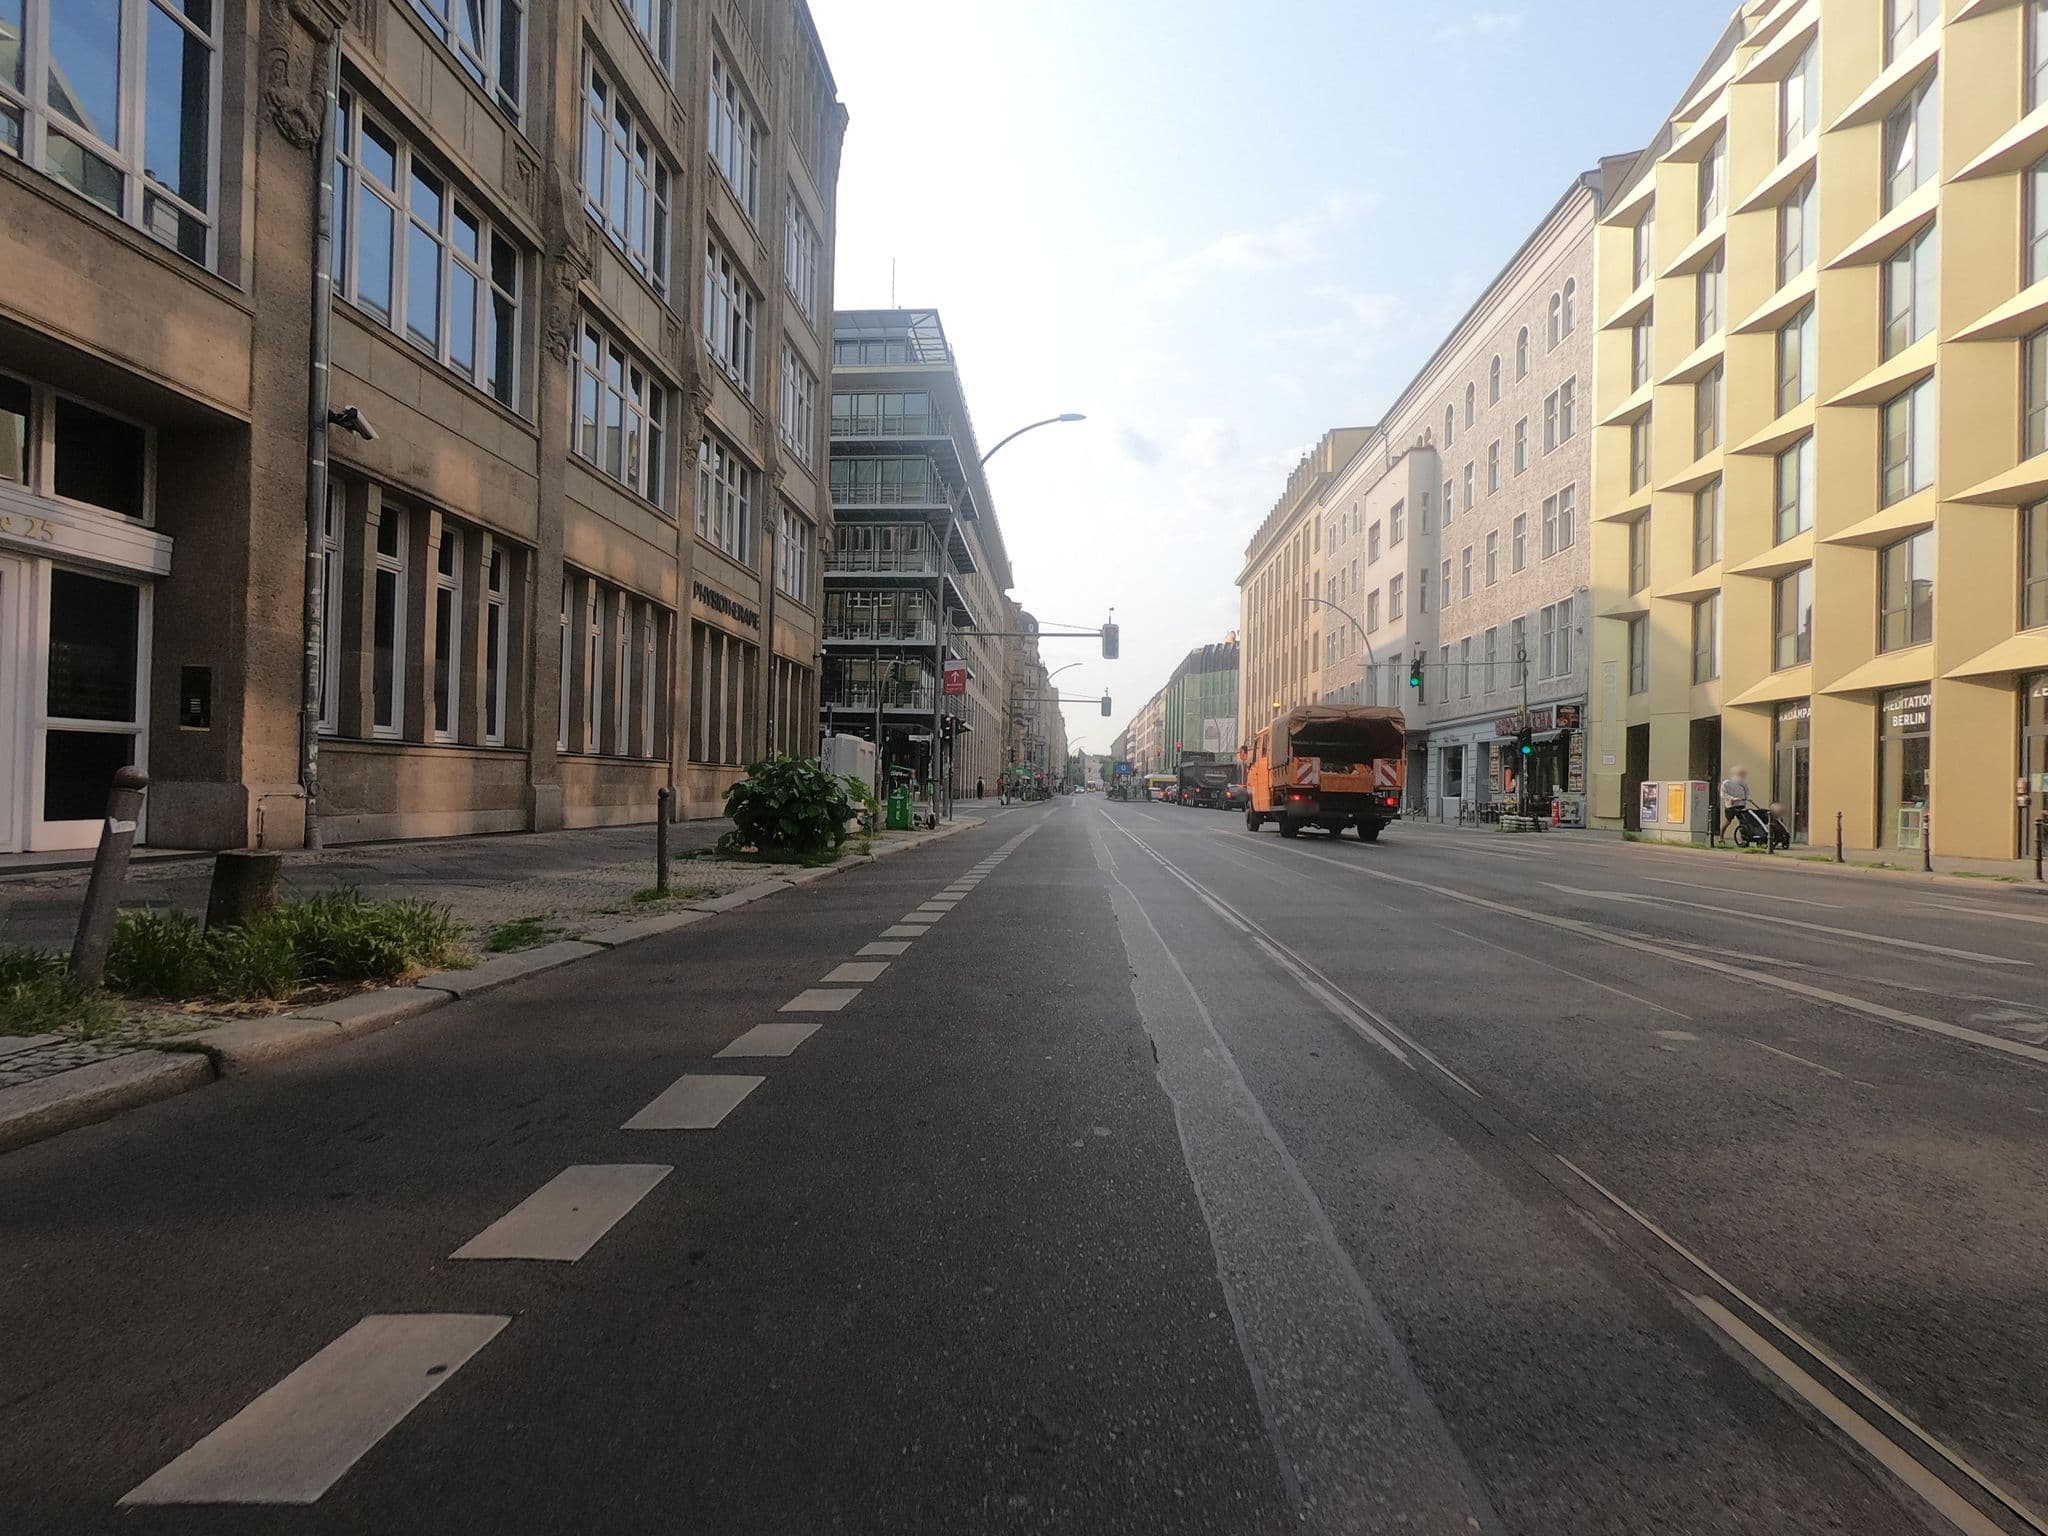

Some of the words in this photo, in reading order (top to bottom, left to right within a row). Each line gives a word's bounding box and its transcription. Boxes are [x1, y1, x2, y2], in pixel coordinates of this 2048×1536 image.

[24, 517, 54, 543] 25
[693, 581, 760, 630] PHYSIOTHERAPIE
[1892, 711, 1926, 727] BERLIN
